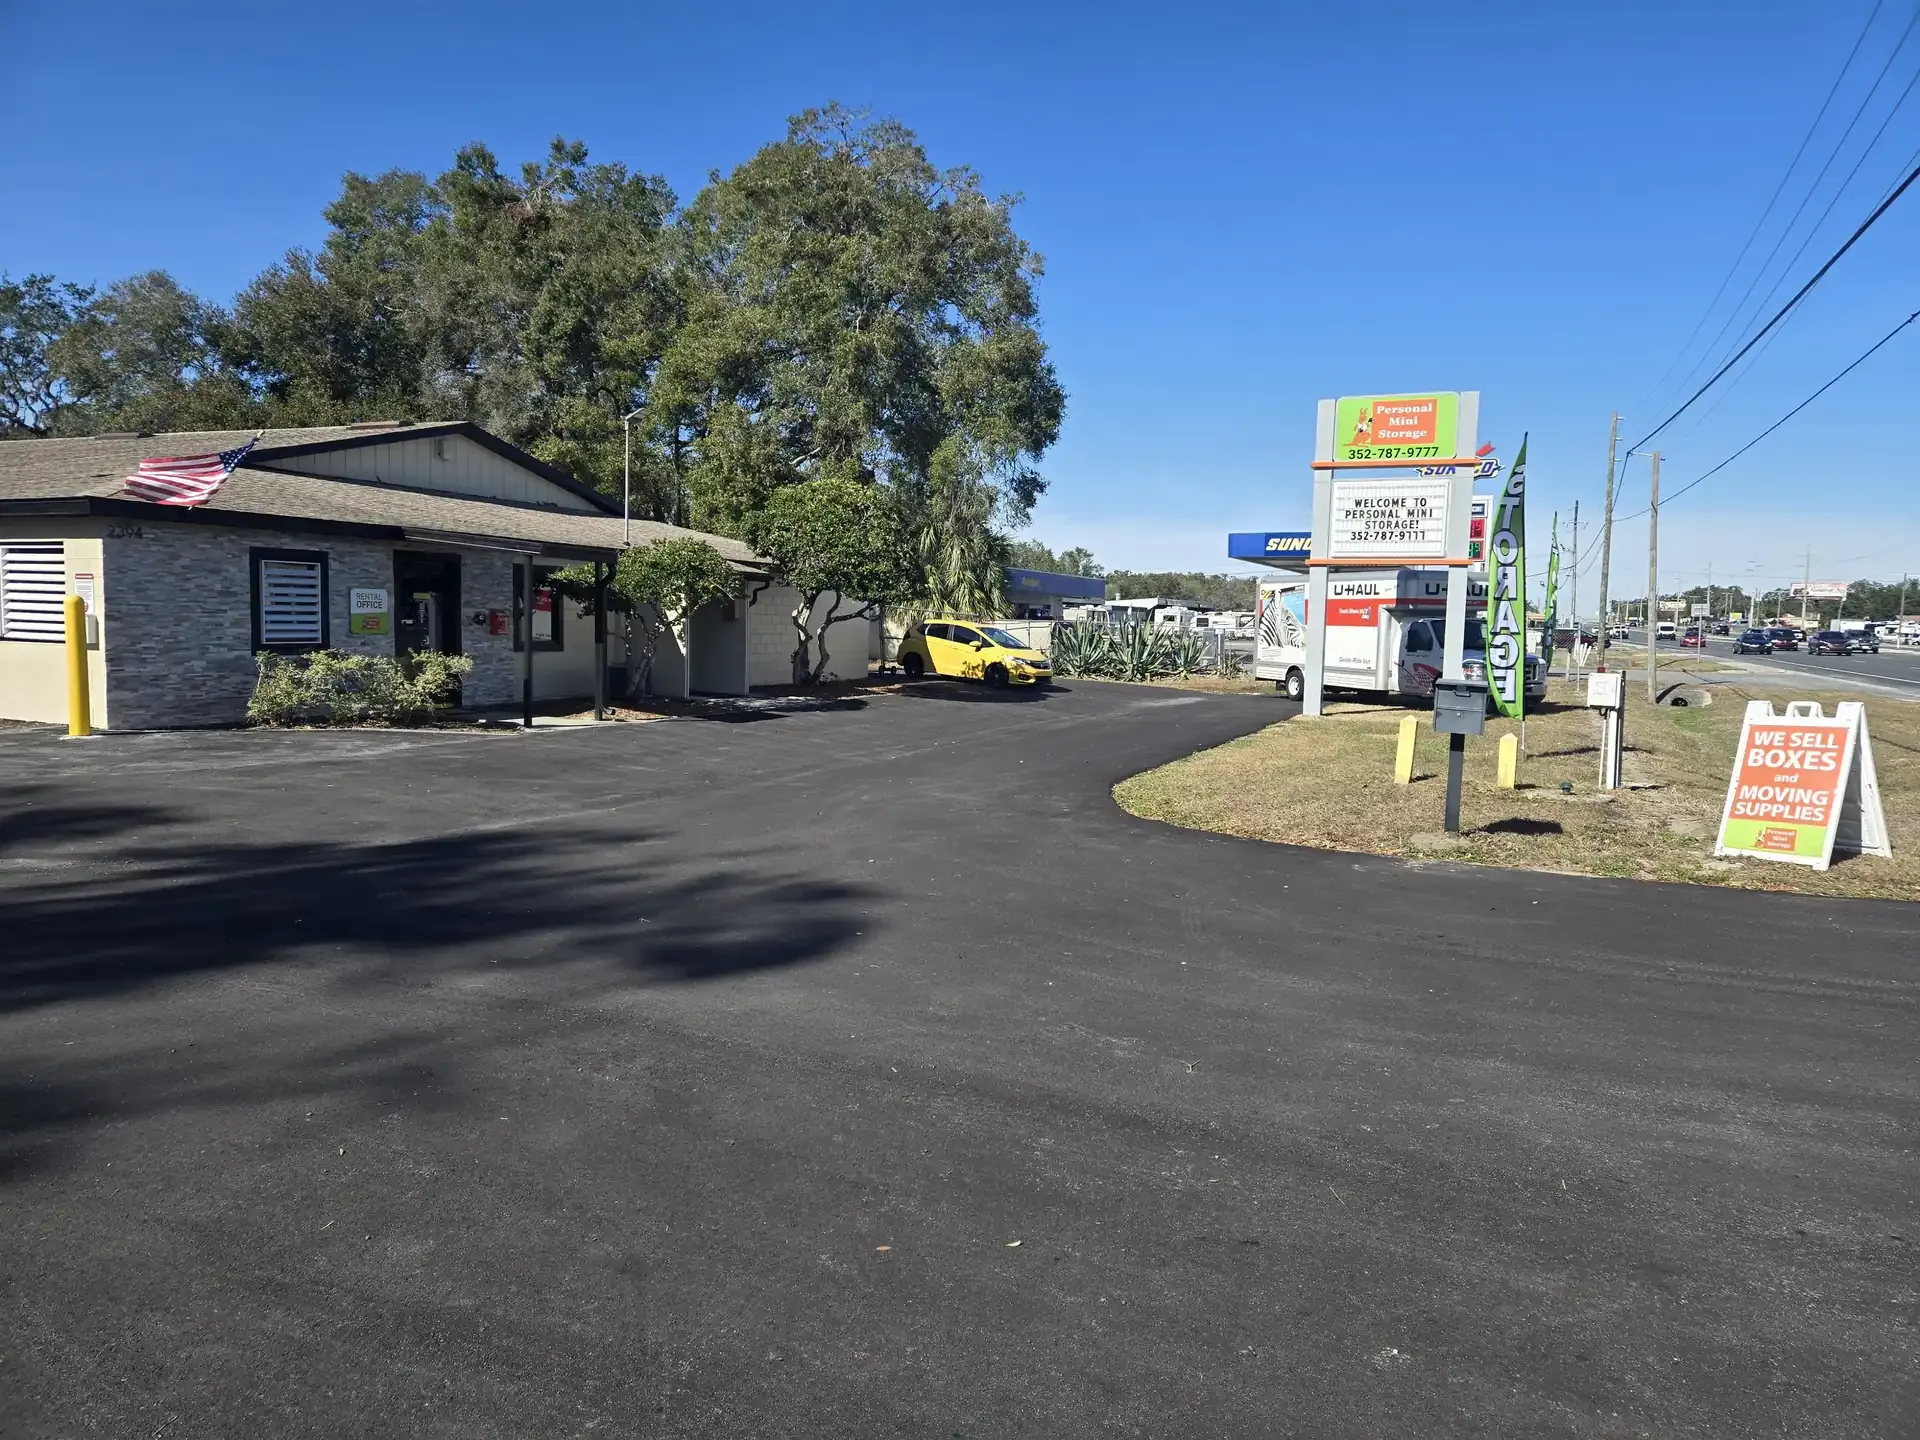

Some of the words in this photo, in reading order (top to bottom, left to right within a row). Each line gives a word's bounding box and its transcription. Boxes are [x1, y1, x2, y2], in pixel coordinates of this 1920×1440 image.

[1376, 403, 1433, 414] Personal
[1389, 416, 1418, 426] Mini
[1378, 429, 1428, 441] Storage
[1348, 447, 1439, 460] 352-787-9777
[1424, 461, 1494, 476] SUNO
[1355, 498, 1407, 508] WELCOME
[1414, 498, 1427, 507] TO
[1345, 509, 1401, 519] PERSONAL
[1407, 509, 1433, 518] MINI
[1365, 520, 1419, 530] STORAGE!
[107, 525, 143, 539] 2394
[1350, 531, 1425, 541] 352-787-9777
[1334, 583, 1380, 596] U-HAUL
[356, 592, 383, 601] RENTAL
[356, 600, 383, 609] OFFICE
[1755, 731, 1786, 746] WE
[1789, 732, 1839, 748] SELL
[1747, 748, 1837, 771] BOXES
[1774, 773, 1799, 783] and
[1739, 785, 1829, 805] MOVING
[1734, 802, 1825, 822] SUPPLIES
